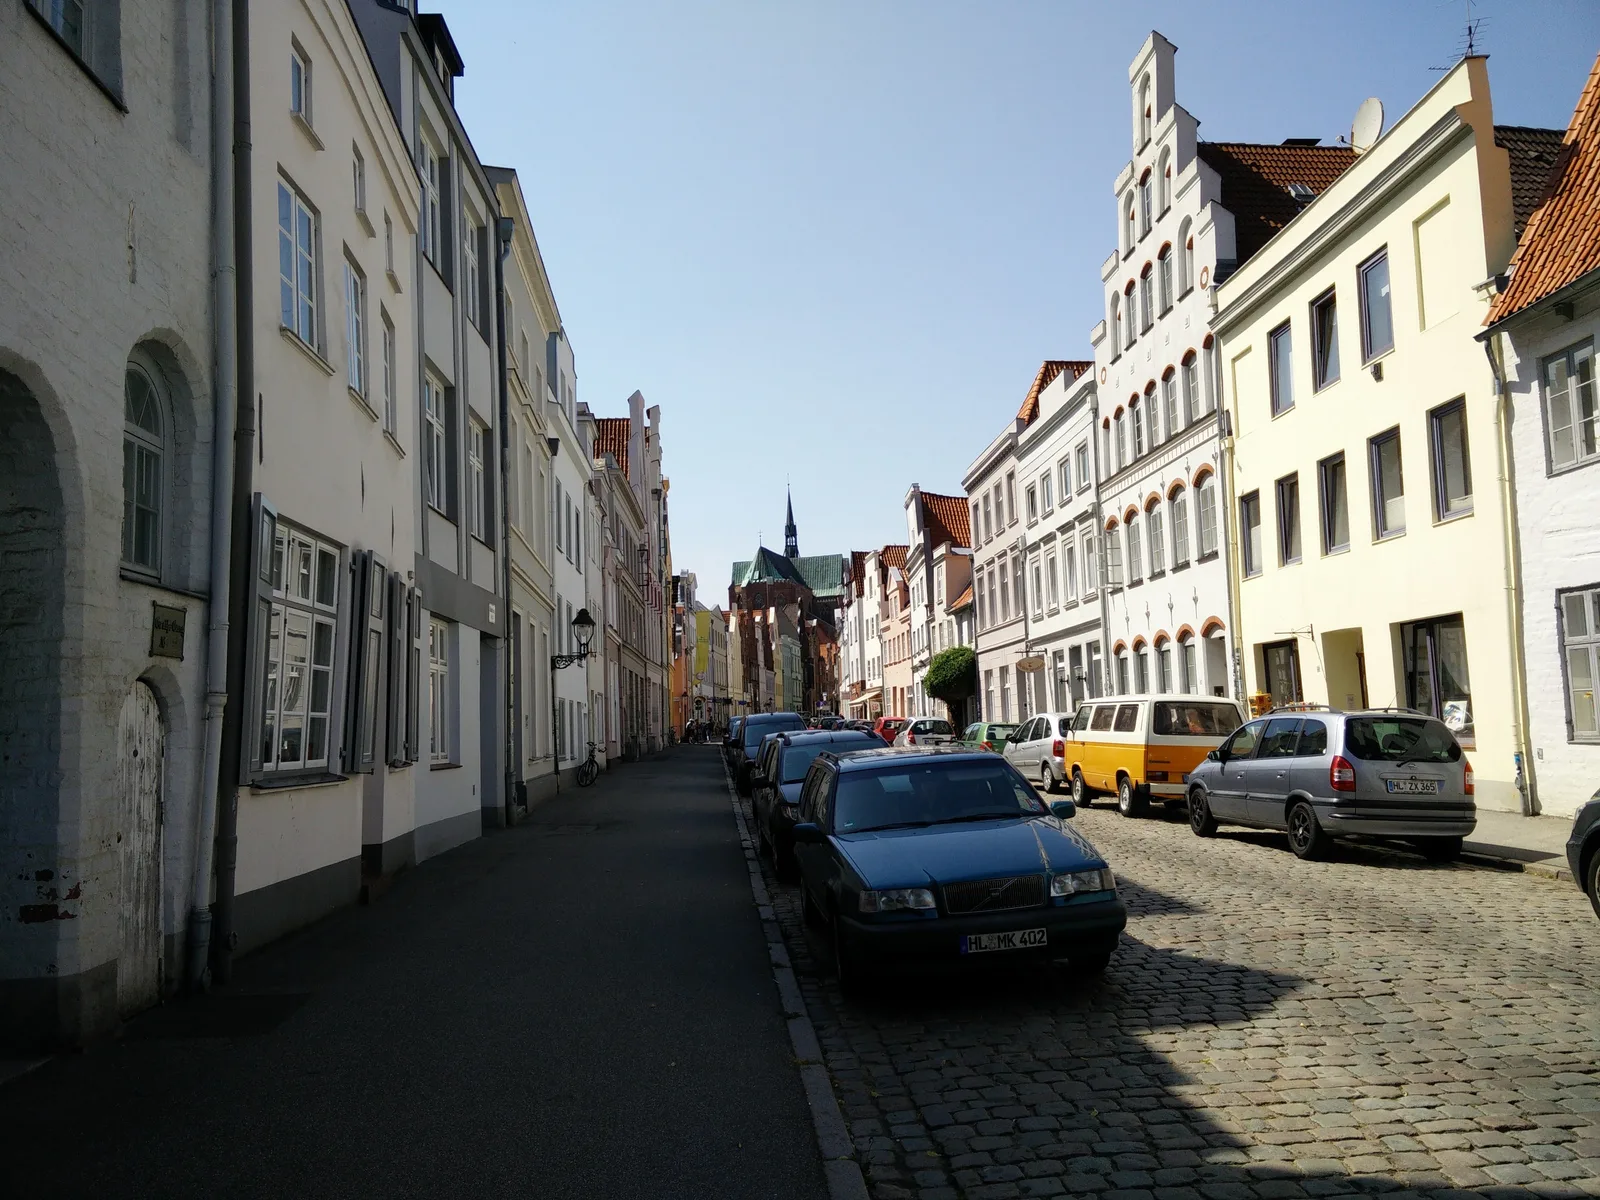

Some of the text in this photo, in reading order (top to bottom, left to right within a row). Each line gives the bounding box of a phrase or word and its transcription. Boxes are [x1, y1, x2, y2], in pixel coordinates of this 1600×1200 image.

[1393, 782, 1436, 792] HL ZX 365
[968, 929, 1046, 951] HL MK 402
